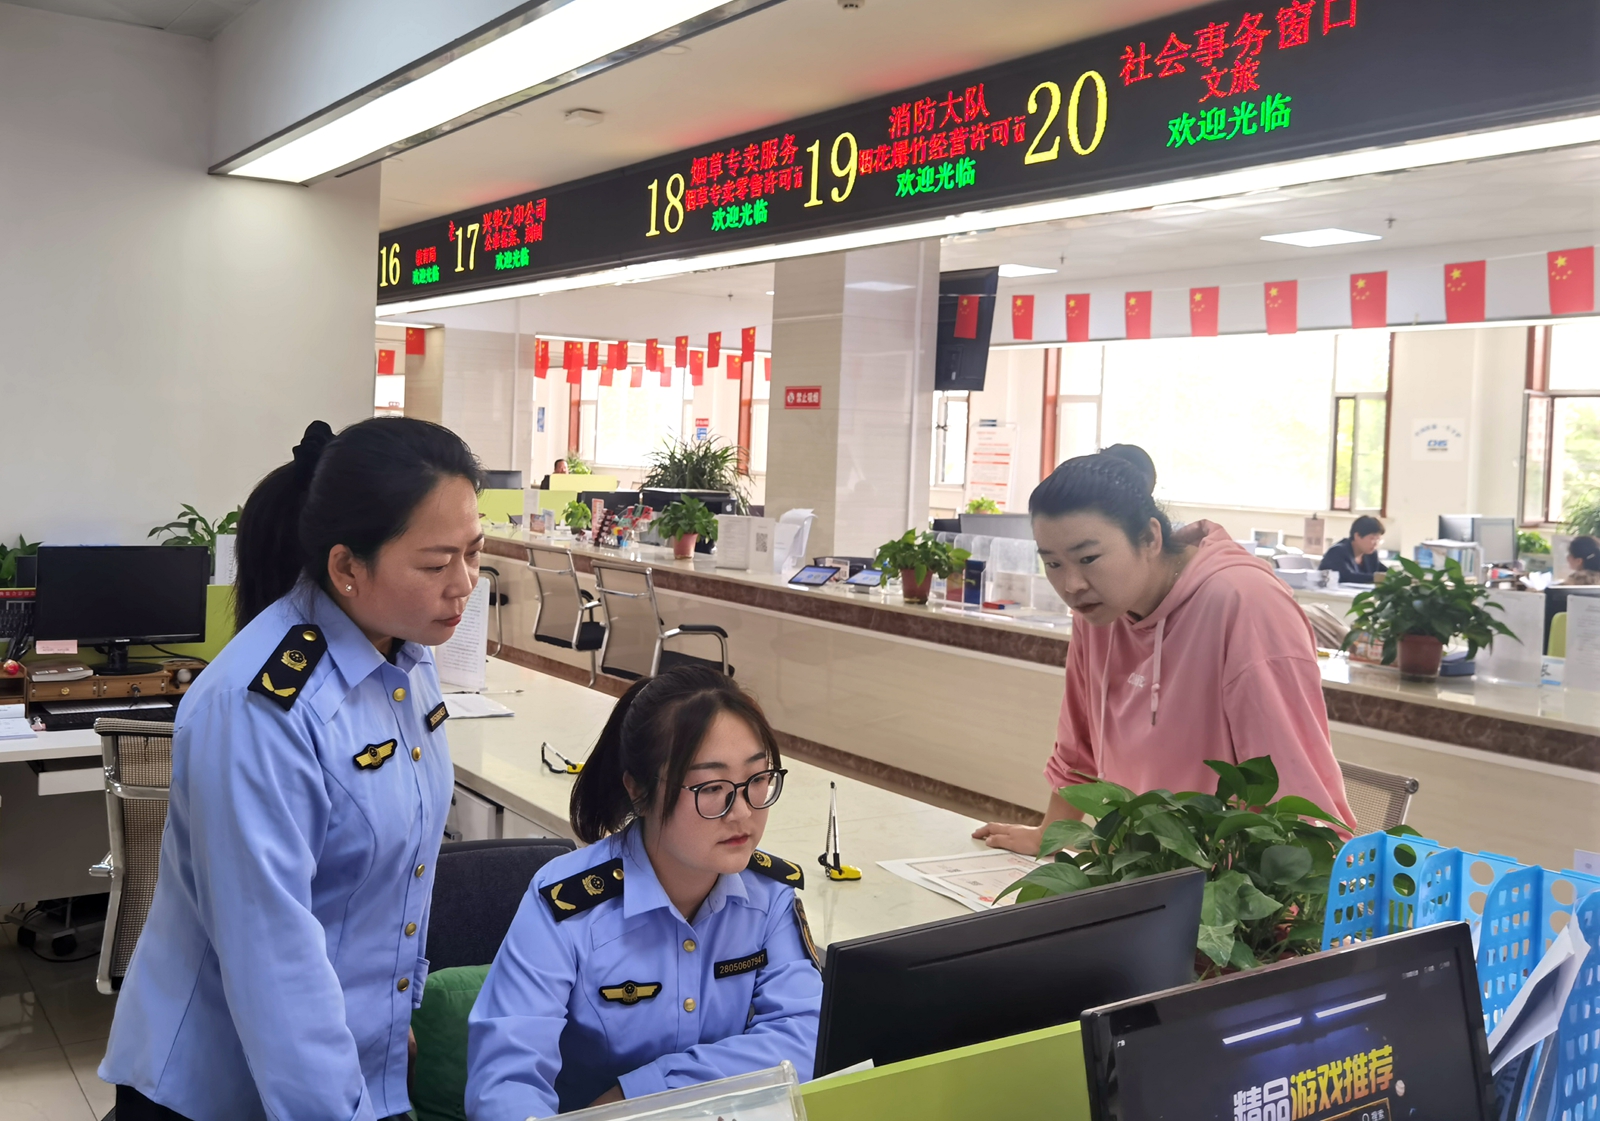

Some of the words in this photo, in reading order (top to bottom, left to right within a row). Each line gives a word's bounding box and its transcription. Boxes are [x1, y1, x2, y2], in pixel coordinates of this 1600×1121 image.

[1119, 0, 1357, 86] 社会事务窗口
[1198, 57, 1260, 103] 文旅
[888, 83, 990, 139] 消防大队
[1024, 70, 1107, 165] 20
[1166, 92, 1292, 148] 欢迎光临
[690, 133, 798, 186] 烟草专卖服务
[803, 132, 858, 207] 19
[895, 156, 976, 197] 欢迎光临
[645, 173, 685, 236] 18
[711, 198, 768, 231] 欢迎光临
[379, 242, 401, 287] 16
[454, 223, 480, 272] 17
[494, 246, 530, 270] 欢迎光临
[412, 265, 440, 285] 欢迎光临
[1233, 1044, 1394, 1121] 精品游戏推荐
